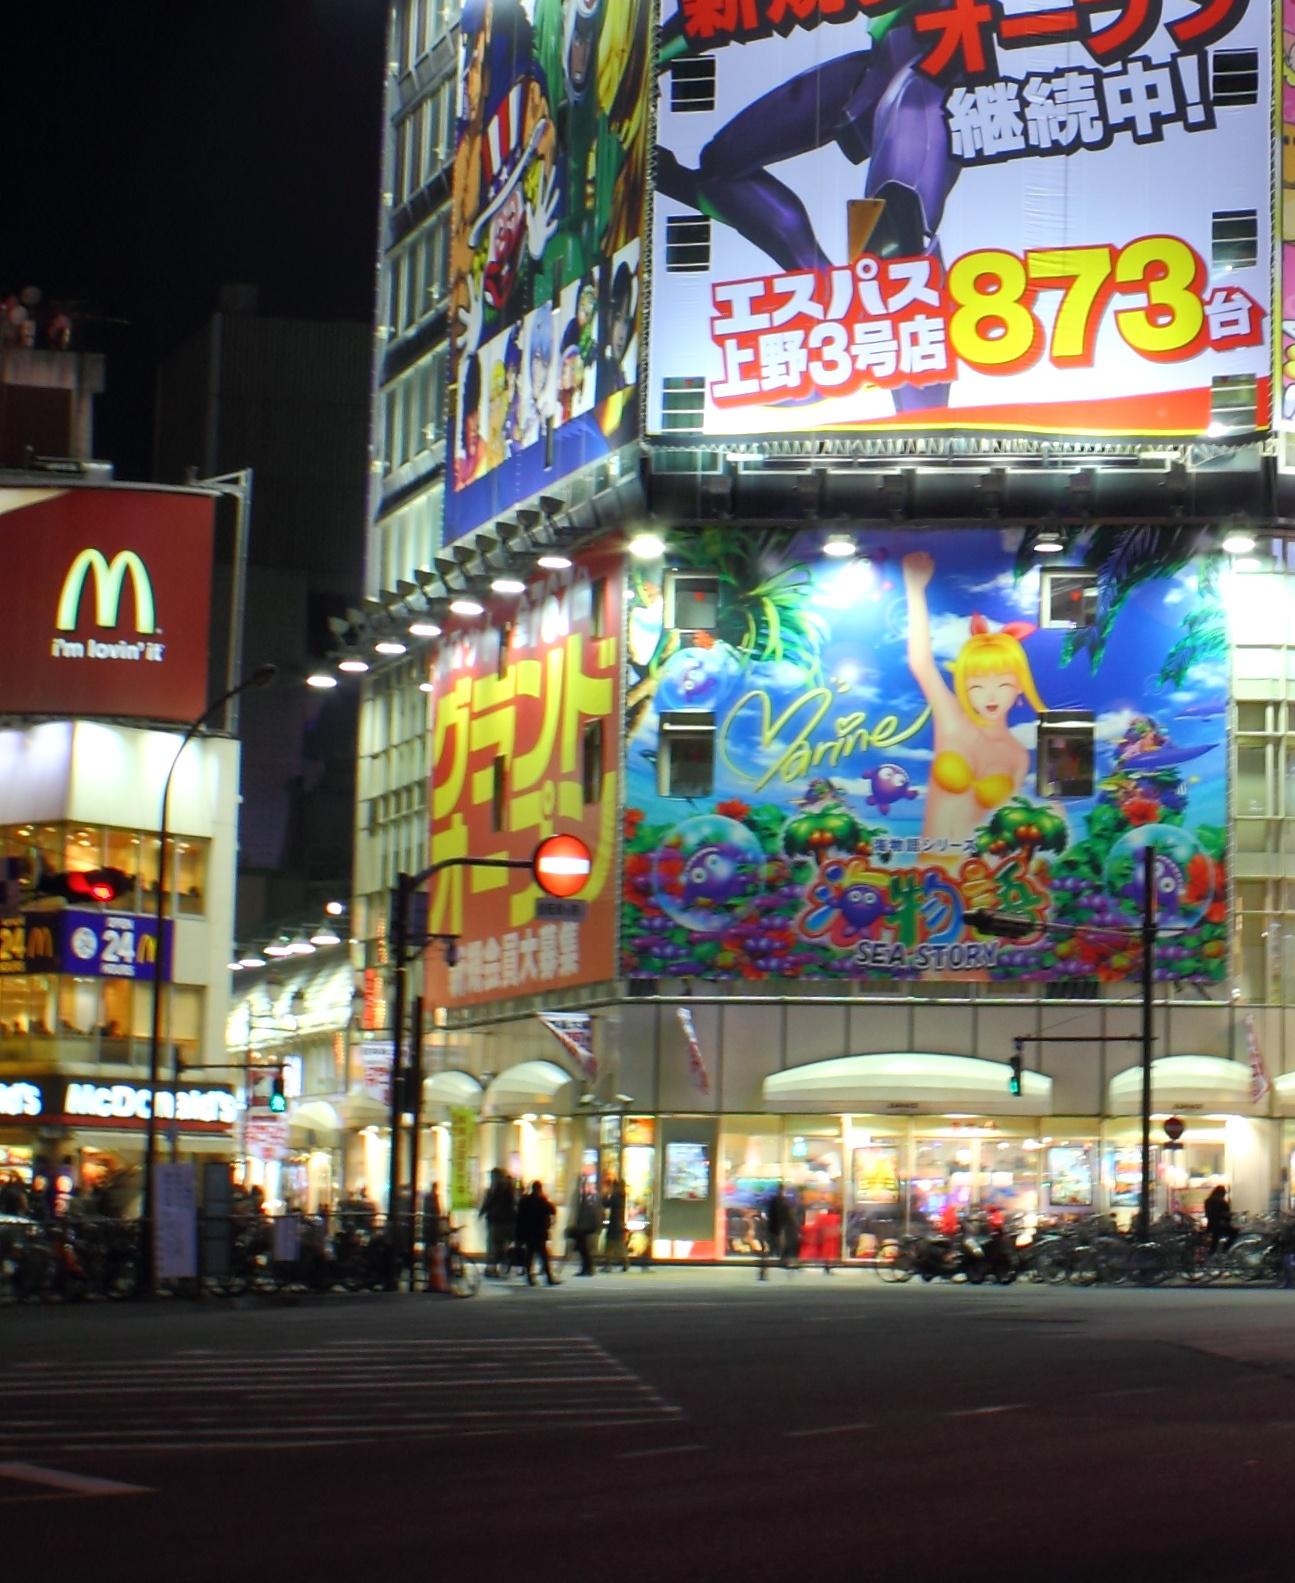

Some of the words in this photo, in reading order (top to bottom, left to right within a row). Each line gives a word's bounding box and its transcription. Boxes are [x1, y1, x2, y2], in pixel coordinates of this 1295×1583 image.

[946, 57, 1209, 161] 継続中!
[711, 257, 942, 338] エスパス
[713, 319, 948, 400] 上野3号店
[51, 638, 84, 659] i'm
[433, 633, 616, 821] グランド
[430, 771, 616, 929] オープン
[101, 929, 135, 963] 24
[855, 939, 908, 966] SEA
[914, 941, 1000, 972] STORY
